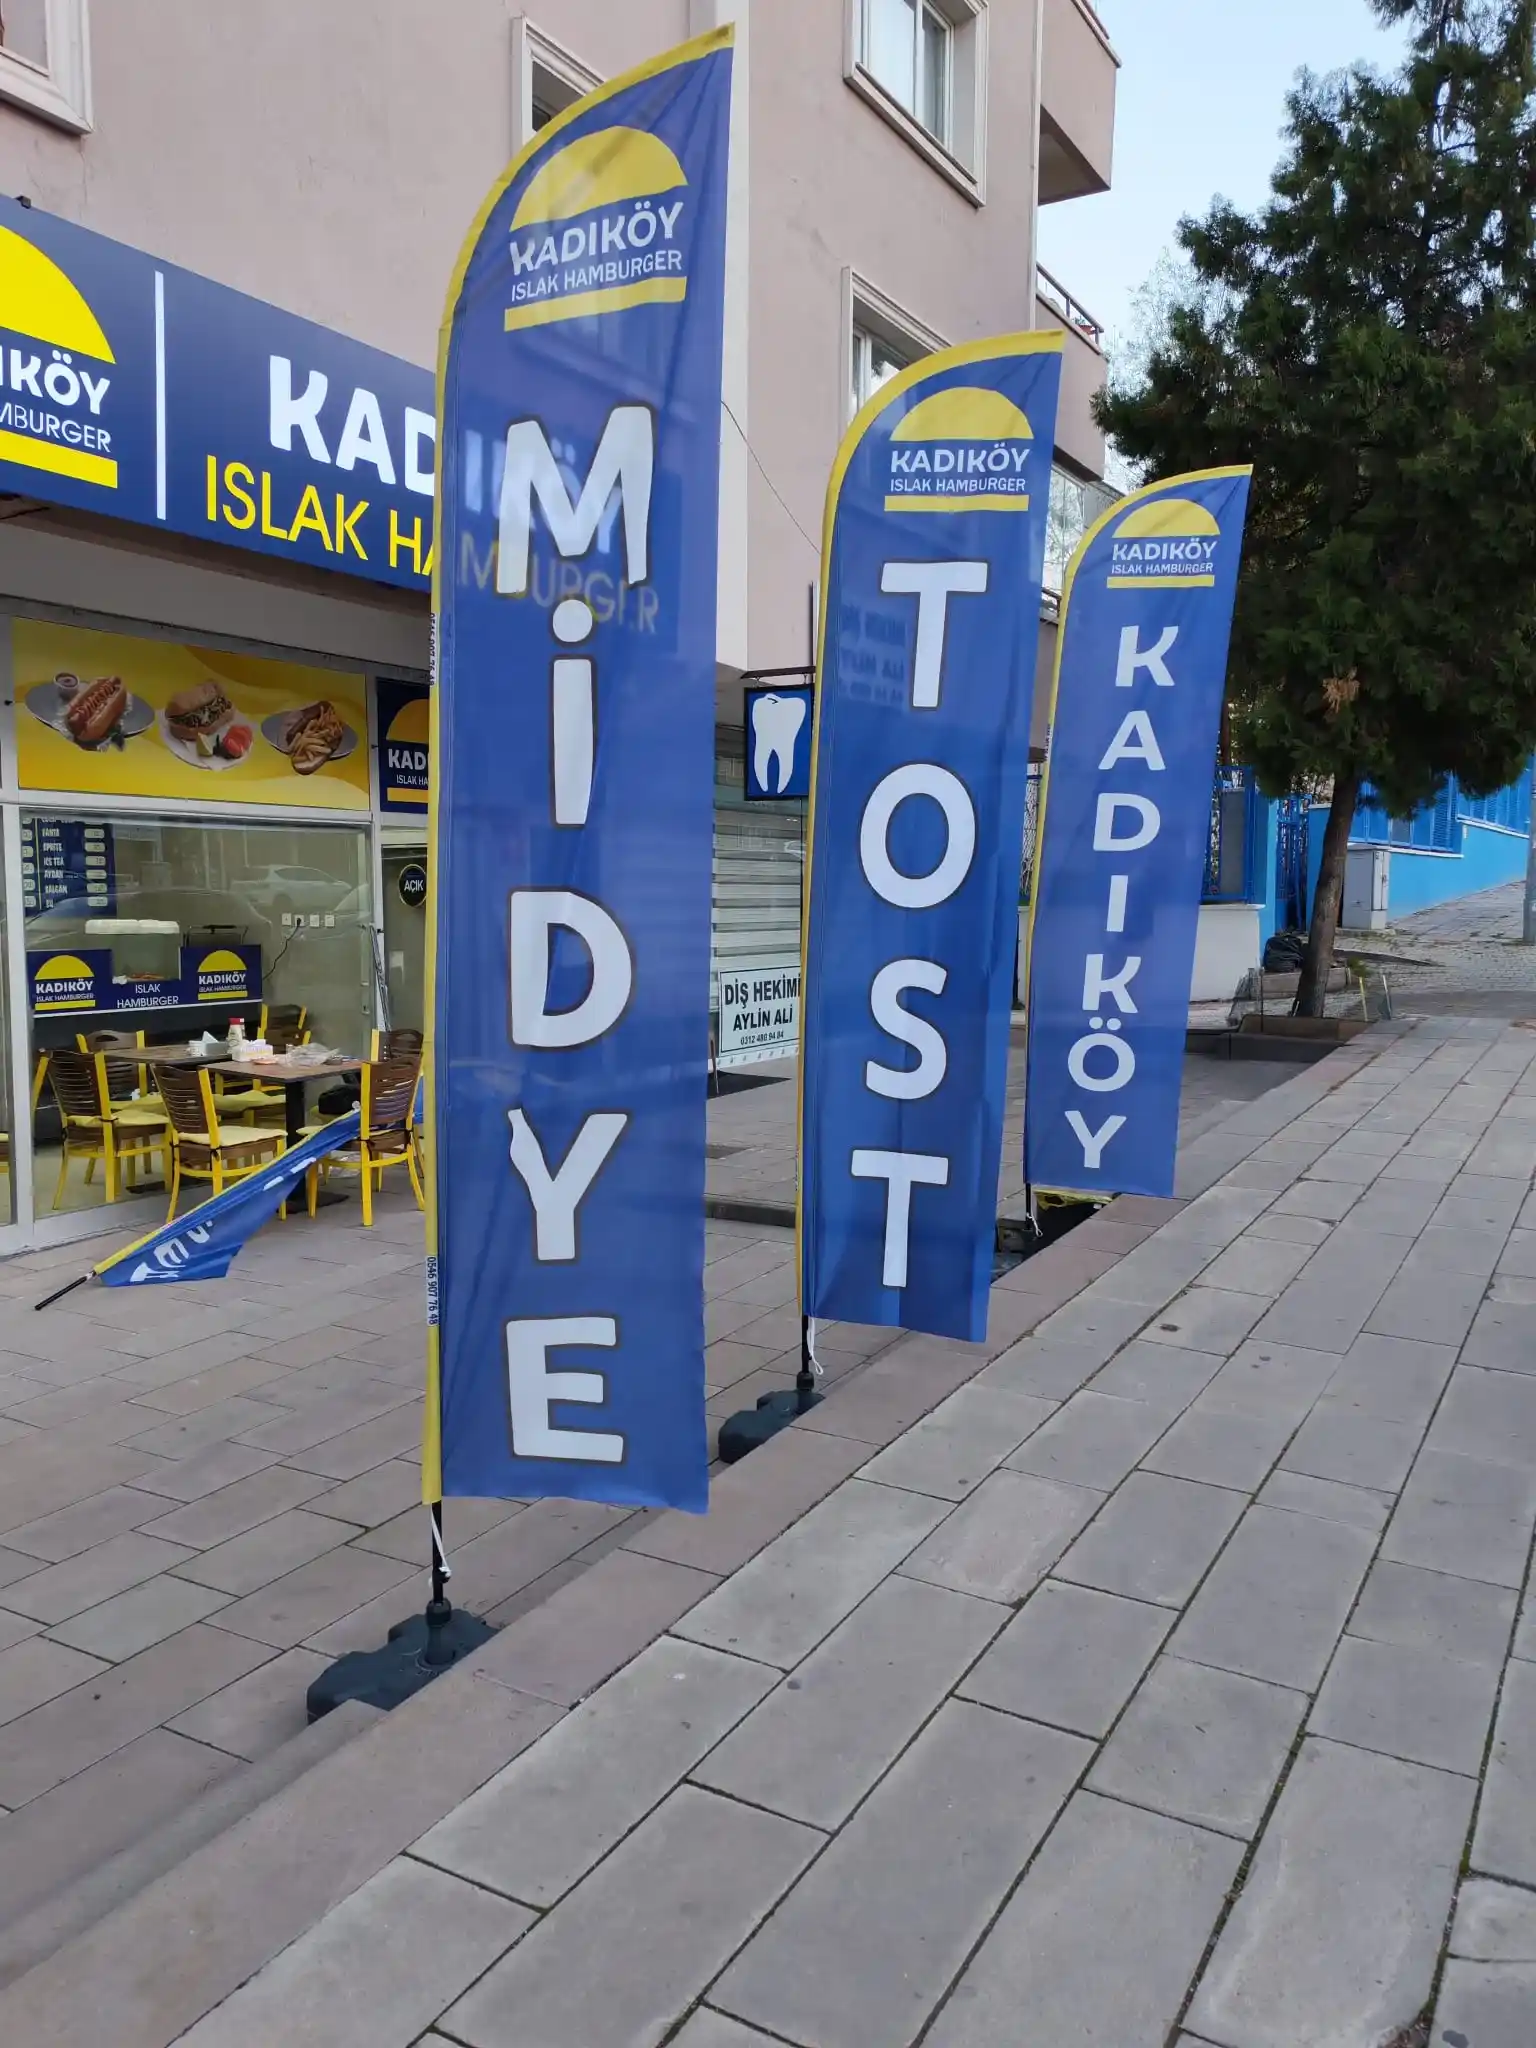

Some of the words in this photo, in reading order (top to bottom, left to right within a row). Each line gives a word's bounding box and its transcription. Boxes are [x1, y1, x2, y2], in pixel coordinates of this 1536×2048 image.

[509, 200, 684, 276] KADIKÖY
[511, 275, 559, 302] ISLAK
[563, 250, 683, 290] HAMBURGER
[890, 442, 1031, 474] KADIKÖY
[890, 478, 932, 493] ISLAK
[936, 477, 1026, 493] HAMBURGER
[206, 455, 370, 561] ISLAK
[1112, 537, 1218, 562] KADIKÖY
[1111, 564, 1142, 575] ISLAK
[1145, 562, 1214, 575] HAMBURGER
[388, 748, 427, 770] KAD
[396, 774, 417, 785] ISLAK
[403, 879, 424, 893] AÇIK
[1063, 625, 1180, 1170] KADIKÖY
[850, 560, 990, 1288] TOST
[35, 978, 94, 994] KADIKÖY
[198, 971, 246, 985] KADIKÖY
[135, 983, 161, 994] ISLAK
[724, 978, 749, 1009] DİŞ
[117, 995, 179, 1009] HAMBURGER
[732, 1007, 771, 1032] AYLİN
[774, 1004, 793, 1026] ALİ
[427, 1256, 437, 1279] 0546
[427, 1281, 438, 1297] 907
[428, 1300, 438, 1312] 76
[428, 1313, 439, 1325] 48
